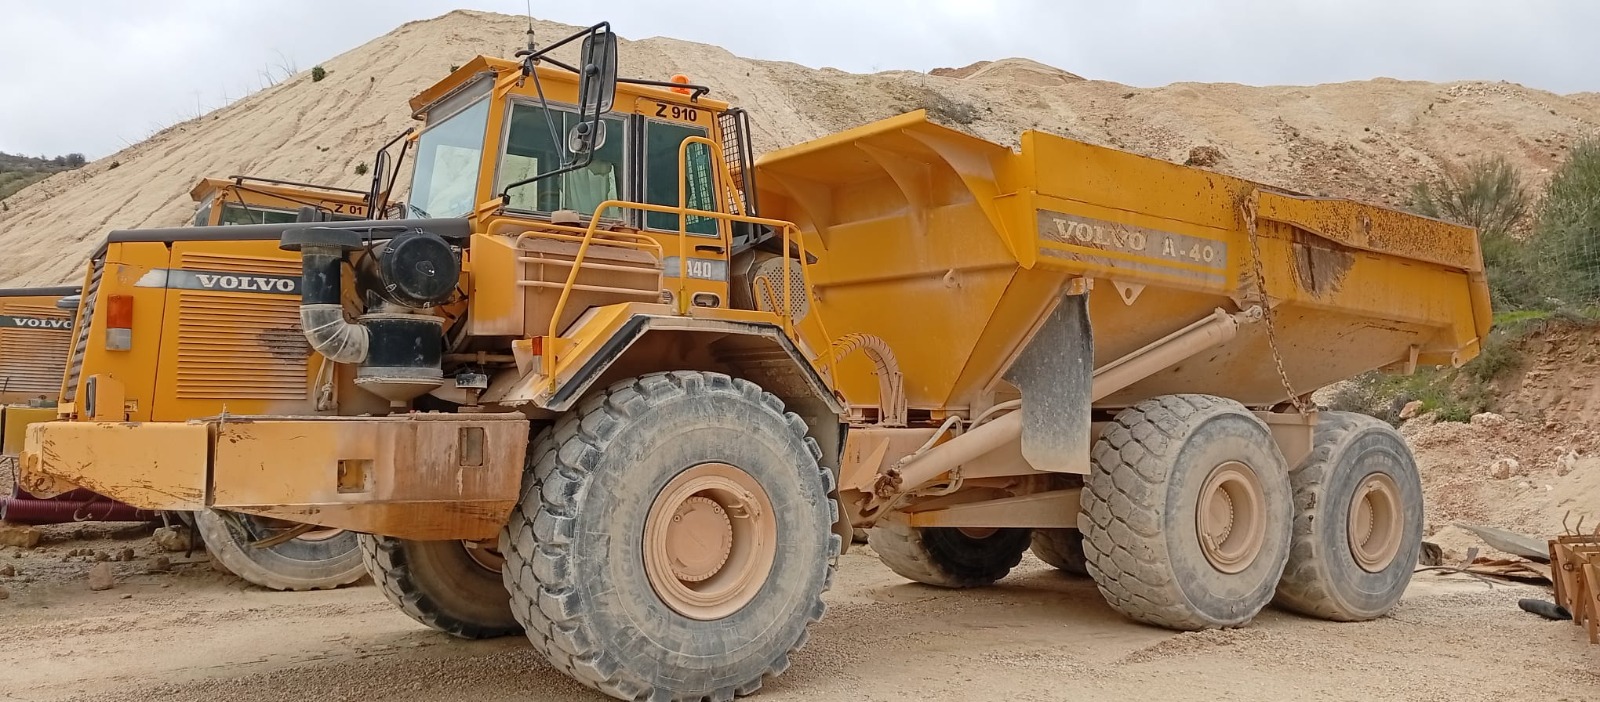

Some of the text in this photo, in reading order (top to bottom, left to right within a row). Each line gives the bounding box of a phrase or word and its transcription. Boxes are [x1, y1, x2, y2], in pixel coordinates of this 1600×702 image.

[656, 103, 697, 122] Z 910
[335, 203, 363, 216] Z 01
[1052, 217, 1214, 263] VOLVO A-40
[195, 274, 295, 292] VOLVO
